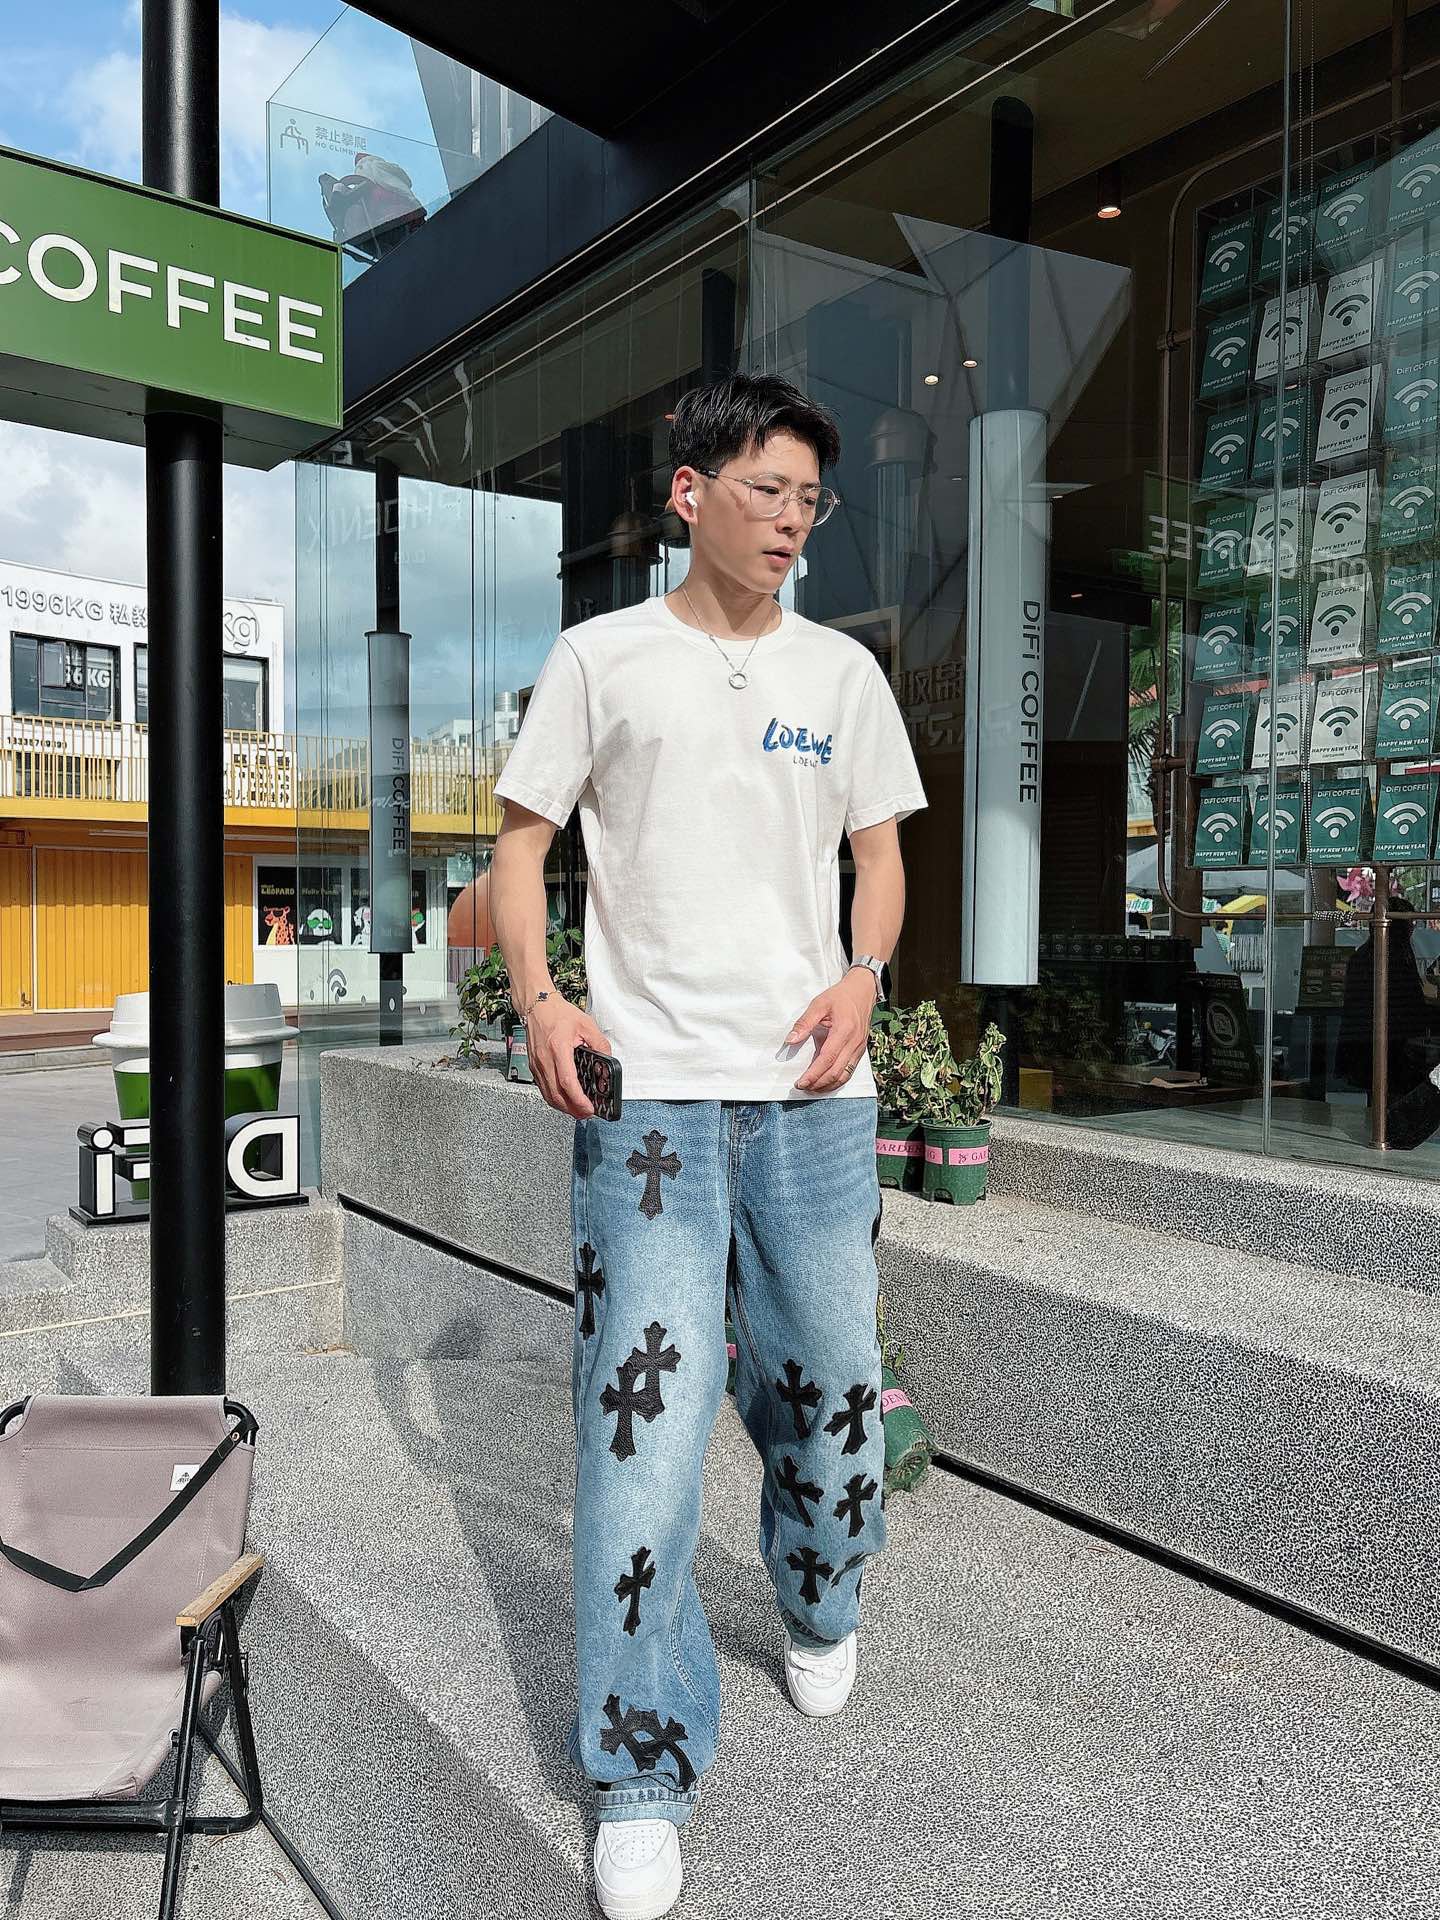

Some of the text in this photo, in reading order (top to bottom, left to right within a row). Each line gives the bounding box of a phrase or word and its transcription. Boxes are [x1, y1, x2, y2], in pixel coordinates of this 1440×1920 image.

[315, 126, 367, 151] 禁止攀爬
[315, 141, 358, 156] NO CLIMBI
[1, 585, 104, 621] 1996KG
[1019, 600, 1041, 803] DiFi COFFEE
[762, 717, 833, 765] LOEWE
[793, 755, 818, 768] LOEW
[1333, 789, 1360, 797] COFFEE
[392, 776, 406, 850] COFFEE
